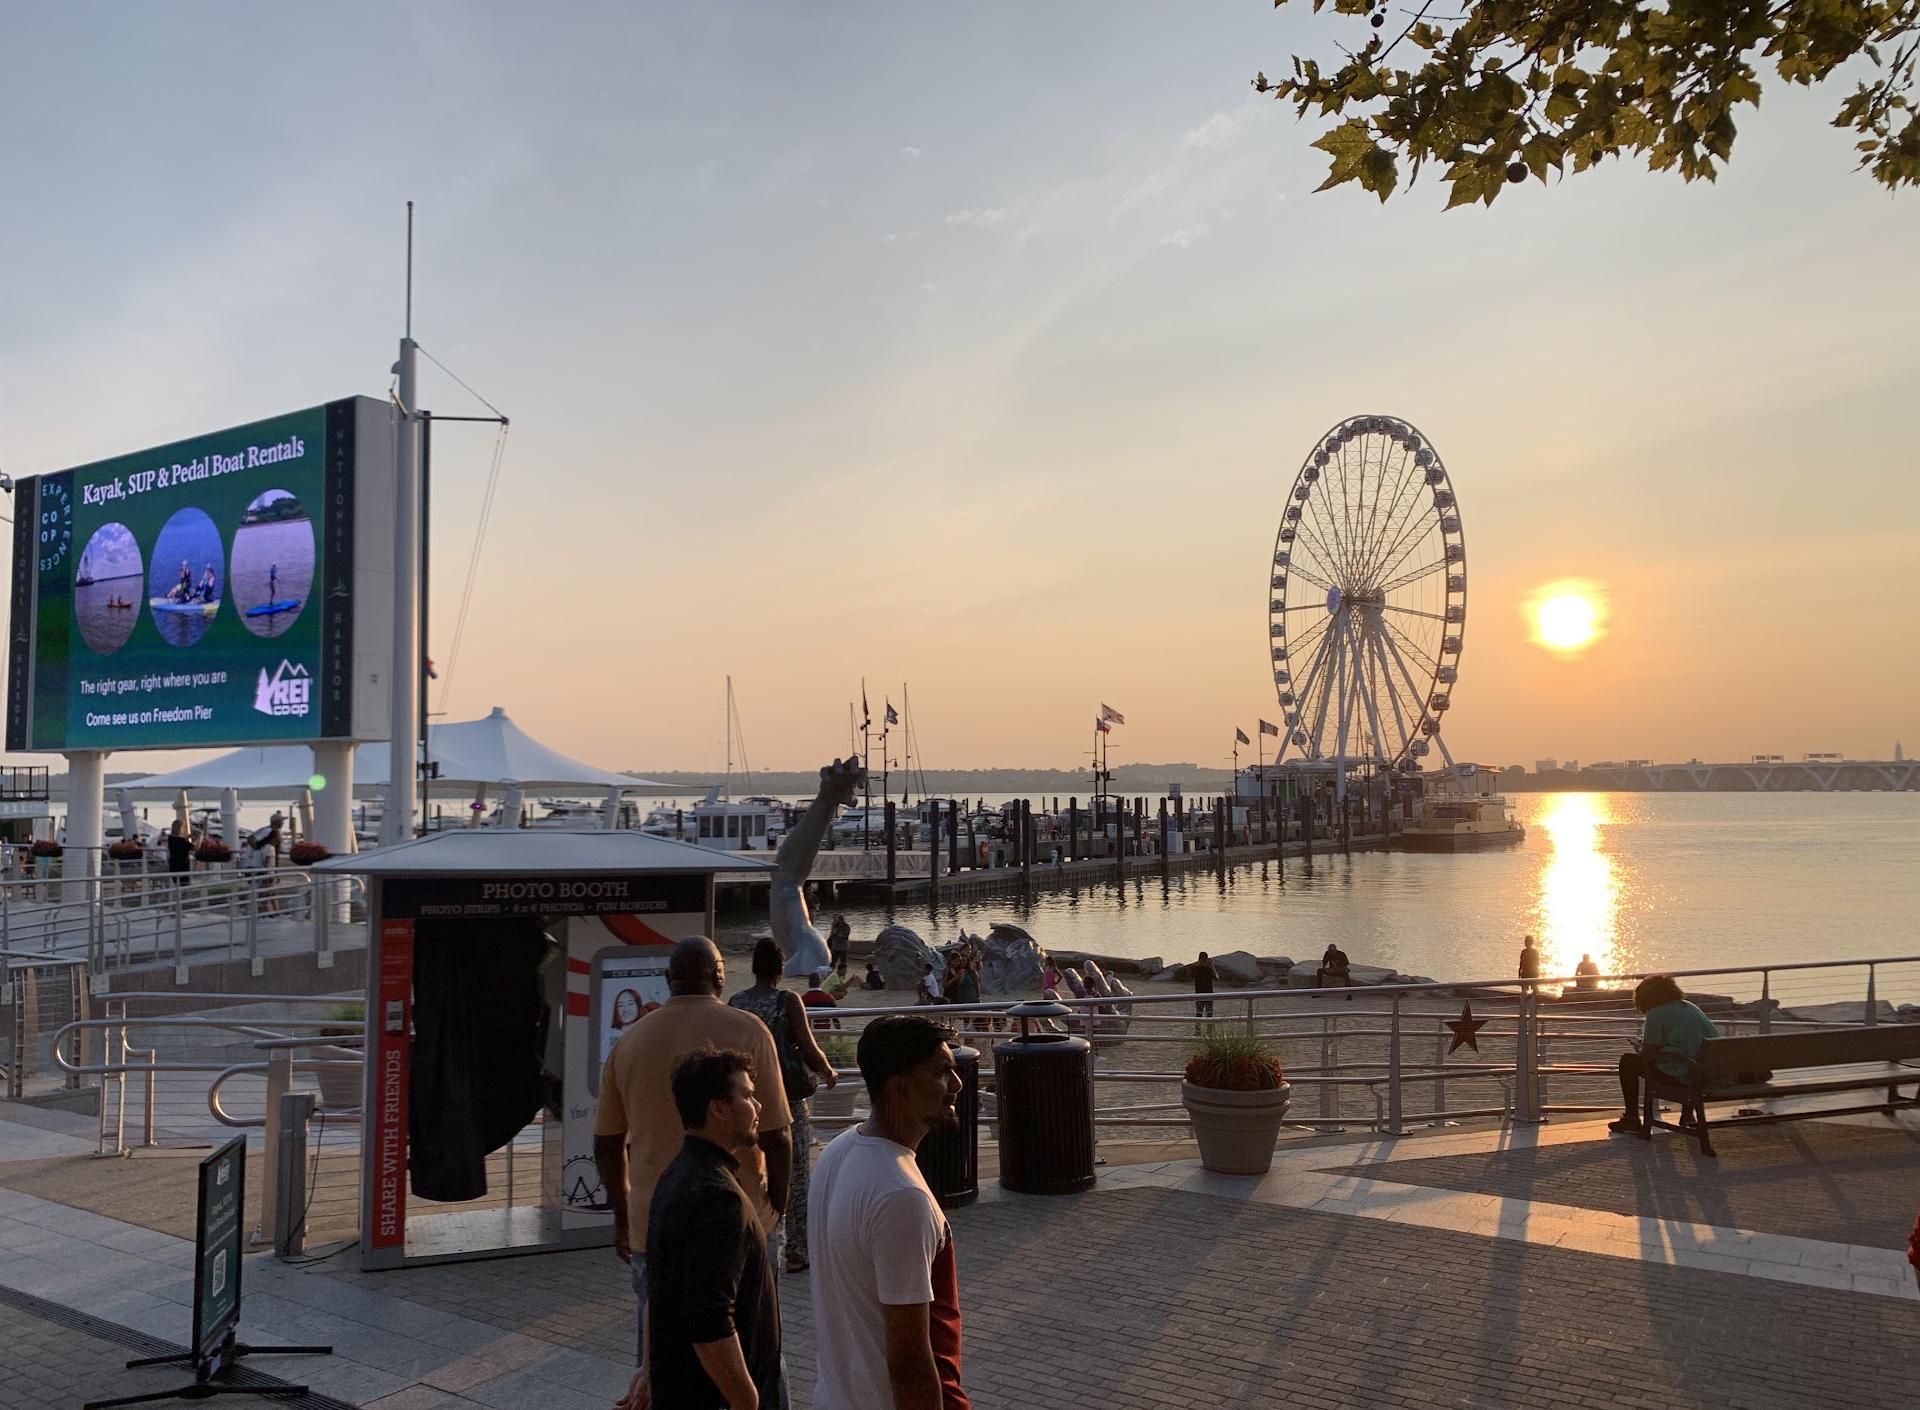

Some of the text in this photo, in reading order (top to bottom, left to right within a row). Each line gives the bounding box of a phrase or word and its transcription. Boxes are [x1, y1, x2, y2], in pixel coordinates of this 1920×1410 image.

[82, 435, 305, 506] Kayak, SUP & Pedal Boat Rentals
[333, 430, 345, 553] NATIONAL
[41, 510, 58, 525] CO
[40, 528, 57, 543] OP
[80, 671, 228, 696] The right gear, right where you are
[273, 677, 310, 705] REI
[86, 704, 213, 727] Come see us on Freedom Pier
[482, 881, 630, 899] PHOTO BOOTH
[420, 904, 462, 916] PHOTO
[539, 902, 585, 913] PHOTOS
[595, 901, 618, 912] FUN
[619, 900, 668, 912] BORDERS
[381, 1049, 401, 1236] SHARE WITH FRIENDS
